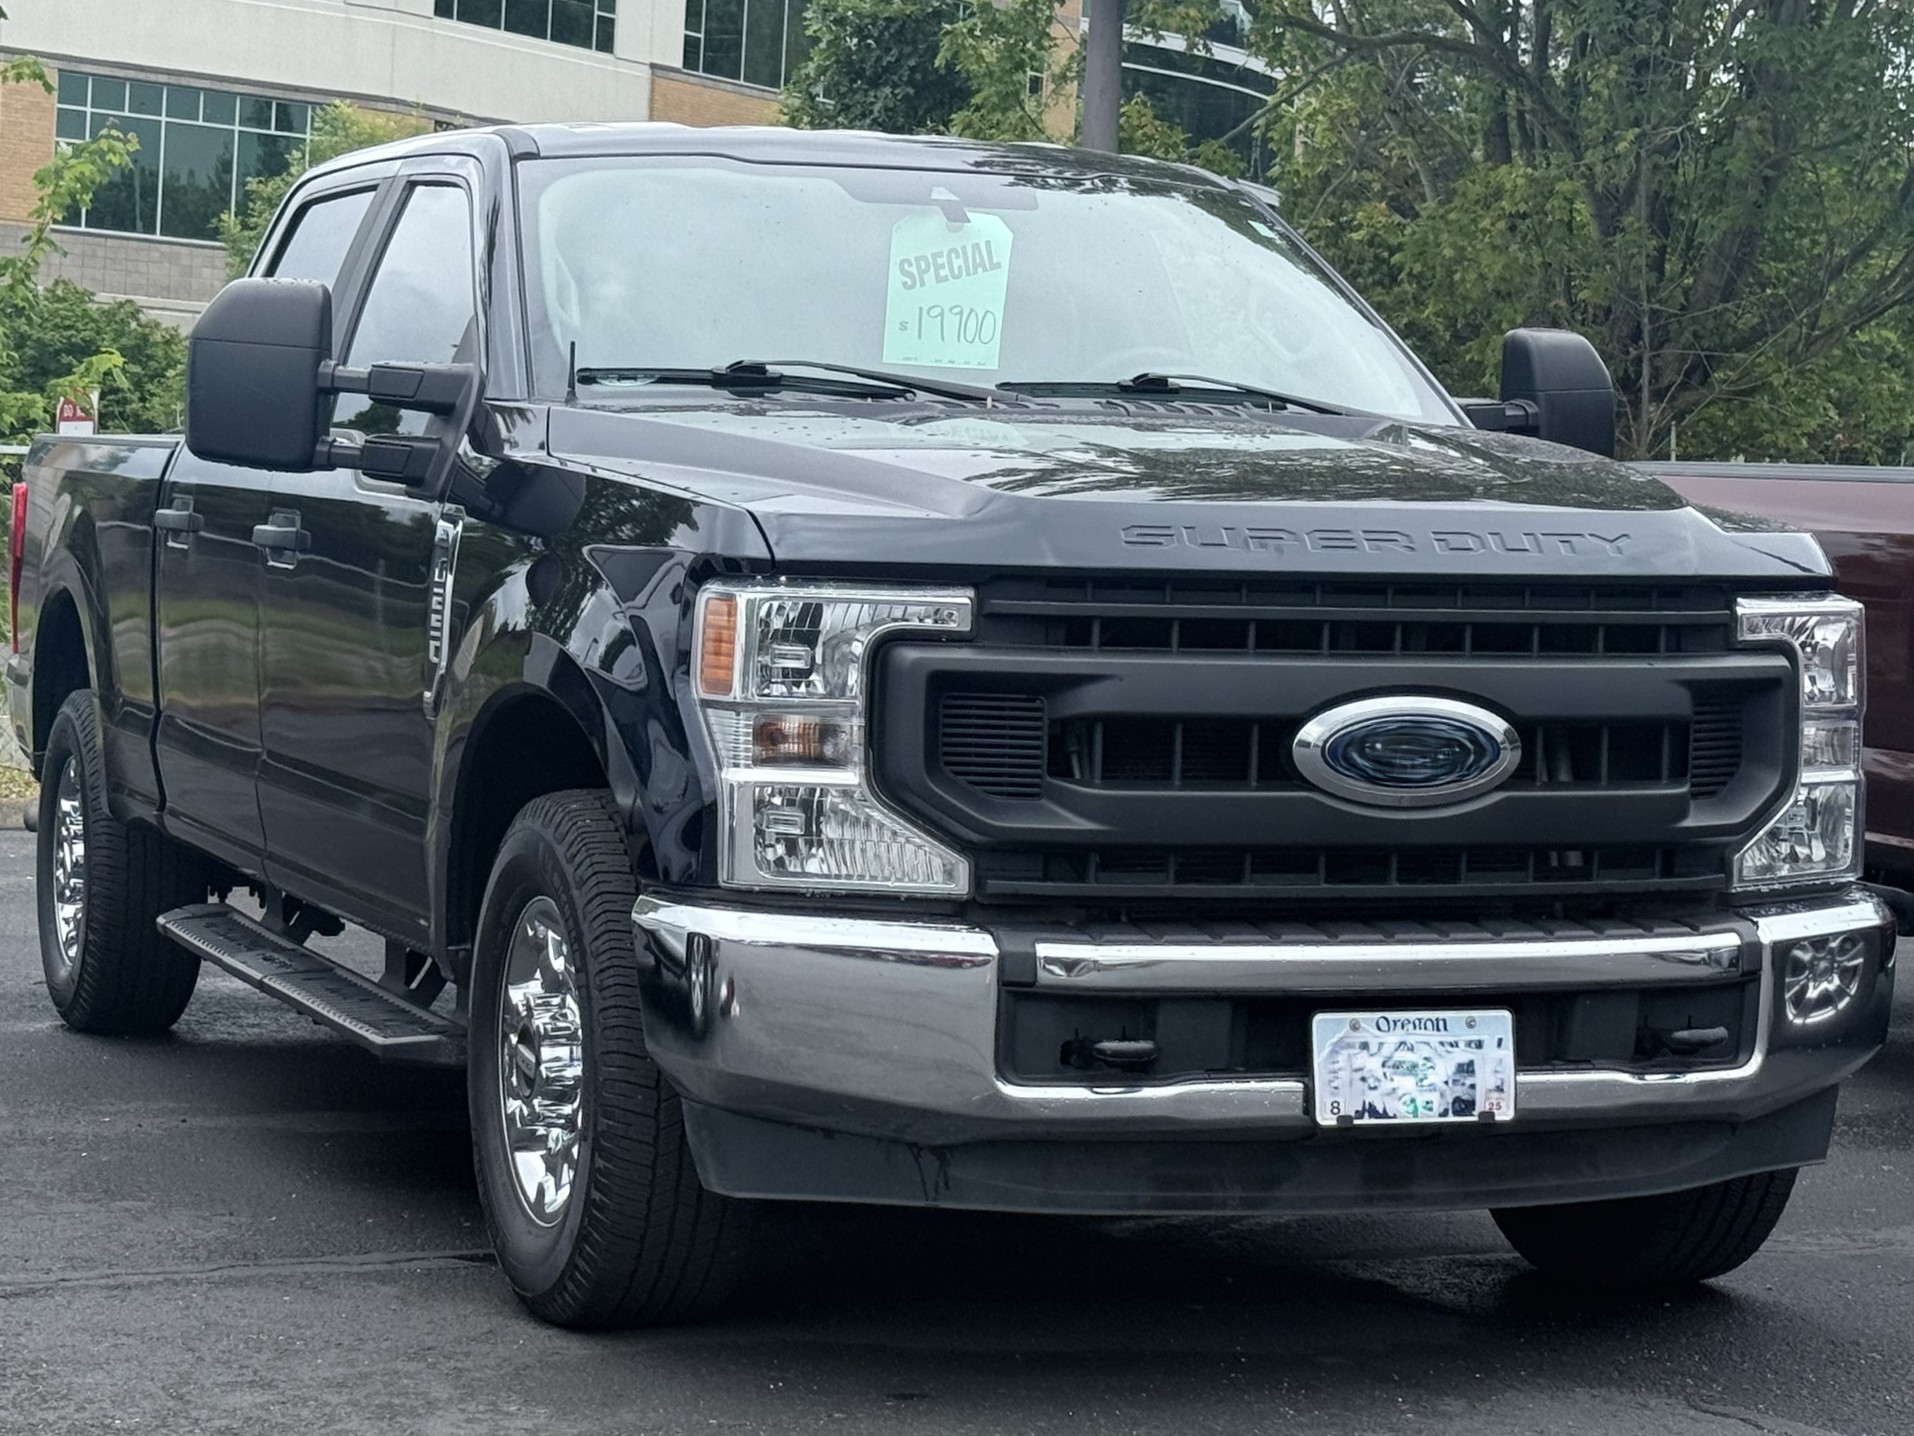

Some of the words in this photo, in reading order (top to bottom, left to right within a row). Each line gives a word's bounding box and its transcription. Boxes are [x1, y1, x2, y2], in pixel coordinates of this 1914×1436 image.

[899, 240, 1001, 290] SPECIAL
[1120, 524, 1416, 554] SUPER
[1430, 530, 1632, 557] DUTY
[1375, 1015, 1449, 1033] Oregon
[1330, 1100, 1341, 1116] 8
[1487, 1100, 1503, 1112] 25
